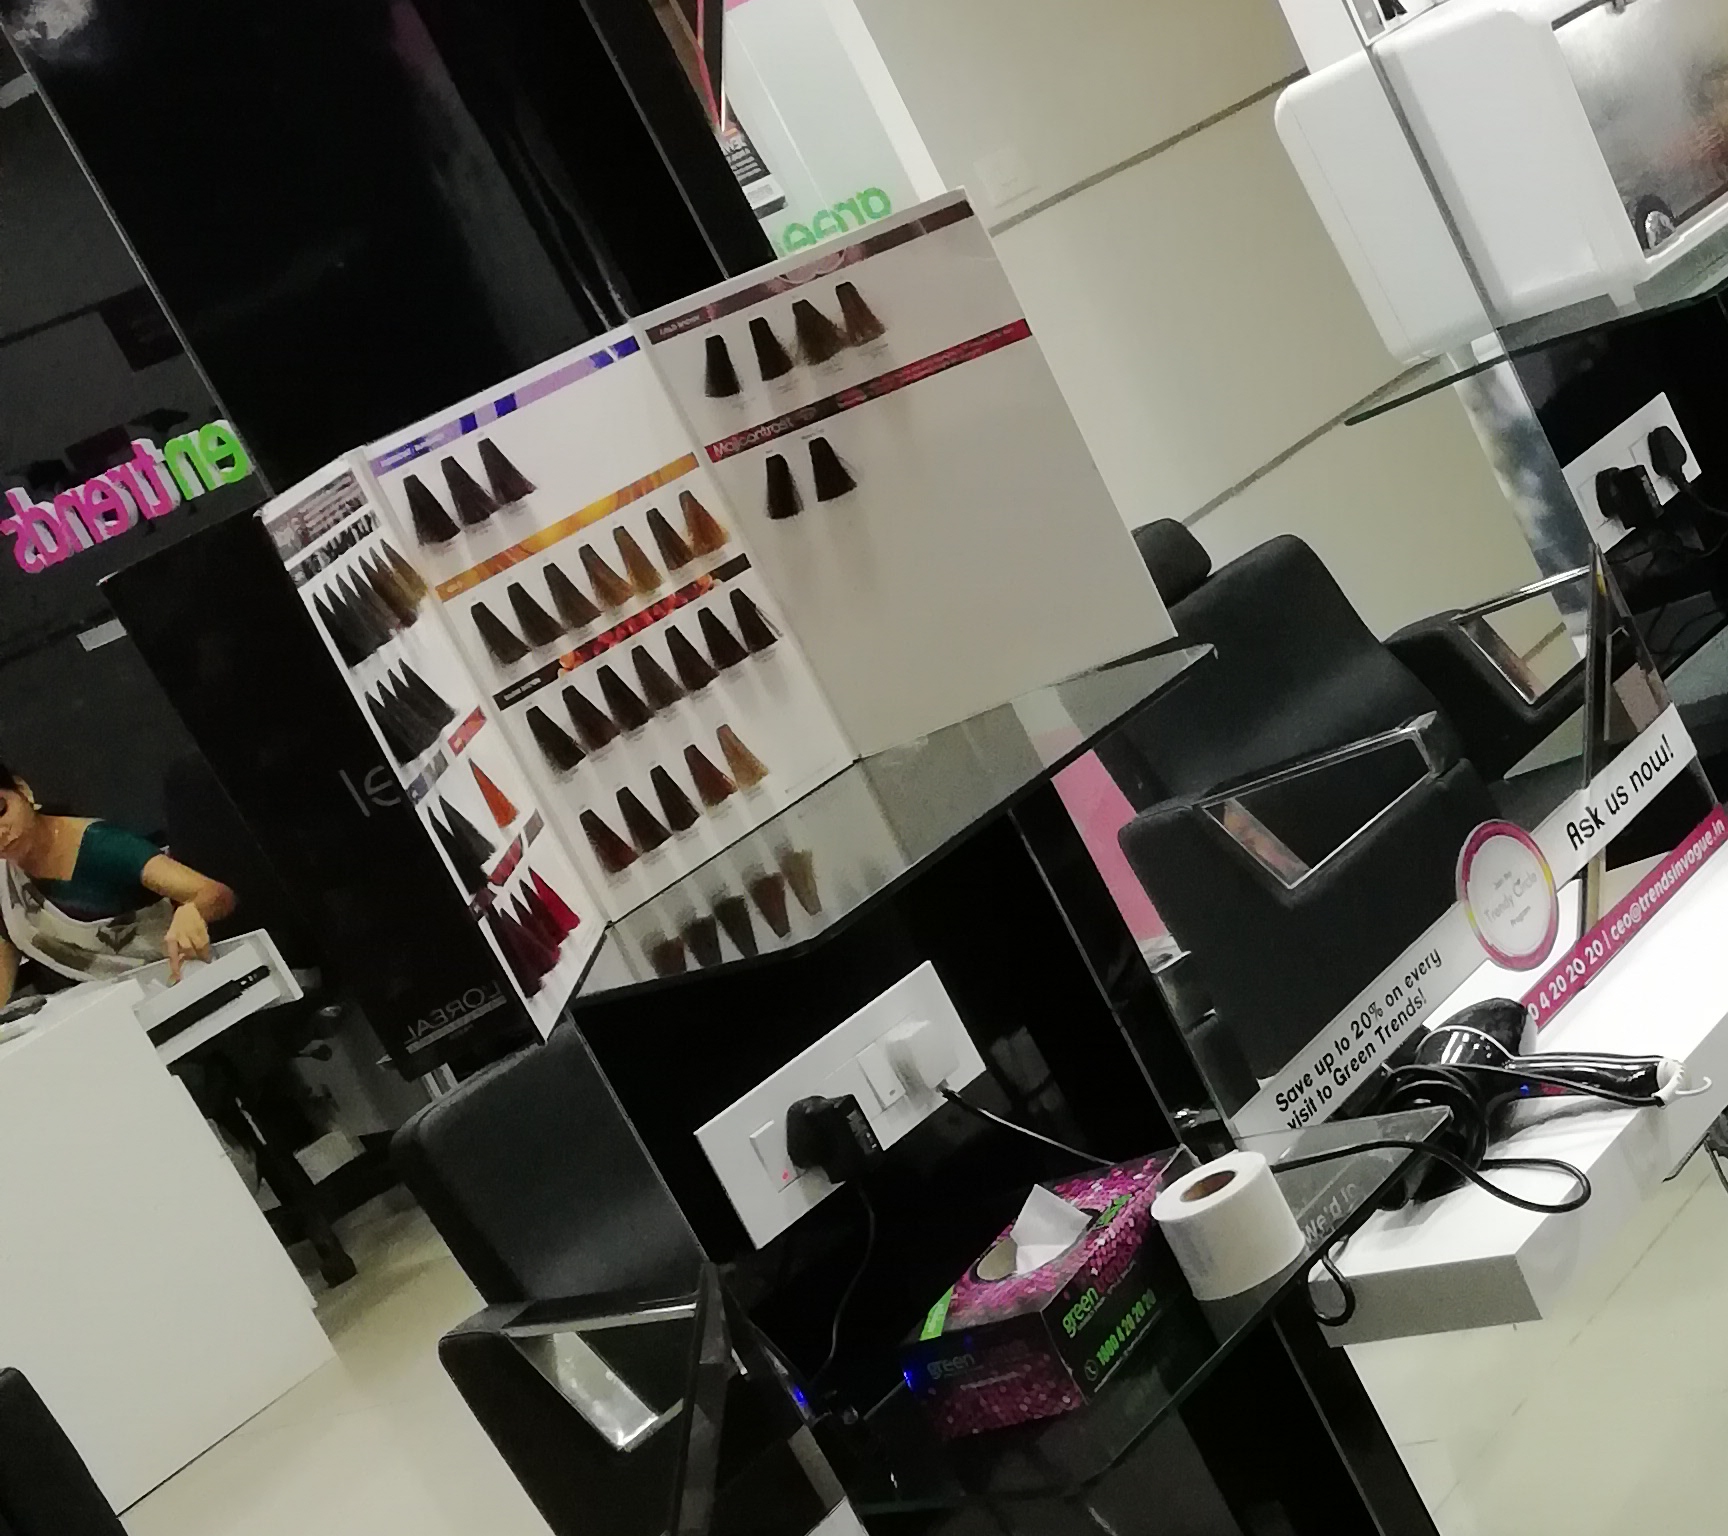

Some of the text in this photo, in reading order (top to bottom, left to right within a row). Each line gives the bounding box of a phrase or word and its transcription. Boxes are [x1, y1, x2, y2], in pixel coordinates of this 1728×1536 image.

[1566, 734, 1675, 851] Ask us now!
[1540, 992, 1551, 1009] 4
[1548, 975, 1567, 1001] 20
[1566, 957, 1586, 984] 20
[1584, 939, 1604, 965] 20
[1610, 817, 1726, 942] ceo@trendsinvogue.in
[1275, 948, 1442, 1112] Save up to 20% on every
[1316, 1085, 1333, 1105] to
[1333, 1042, 1377, 1087] Green
[1374, 987, 1428, 1046] Trends!
[1063, 1287, 1099, 1339] green
